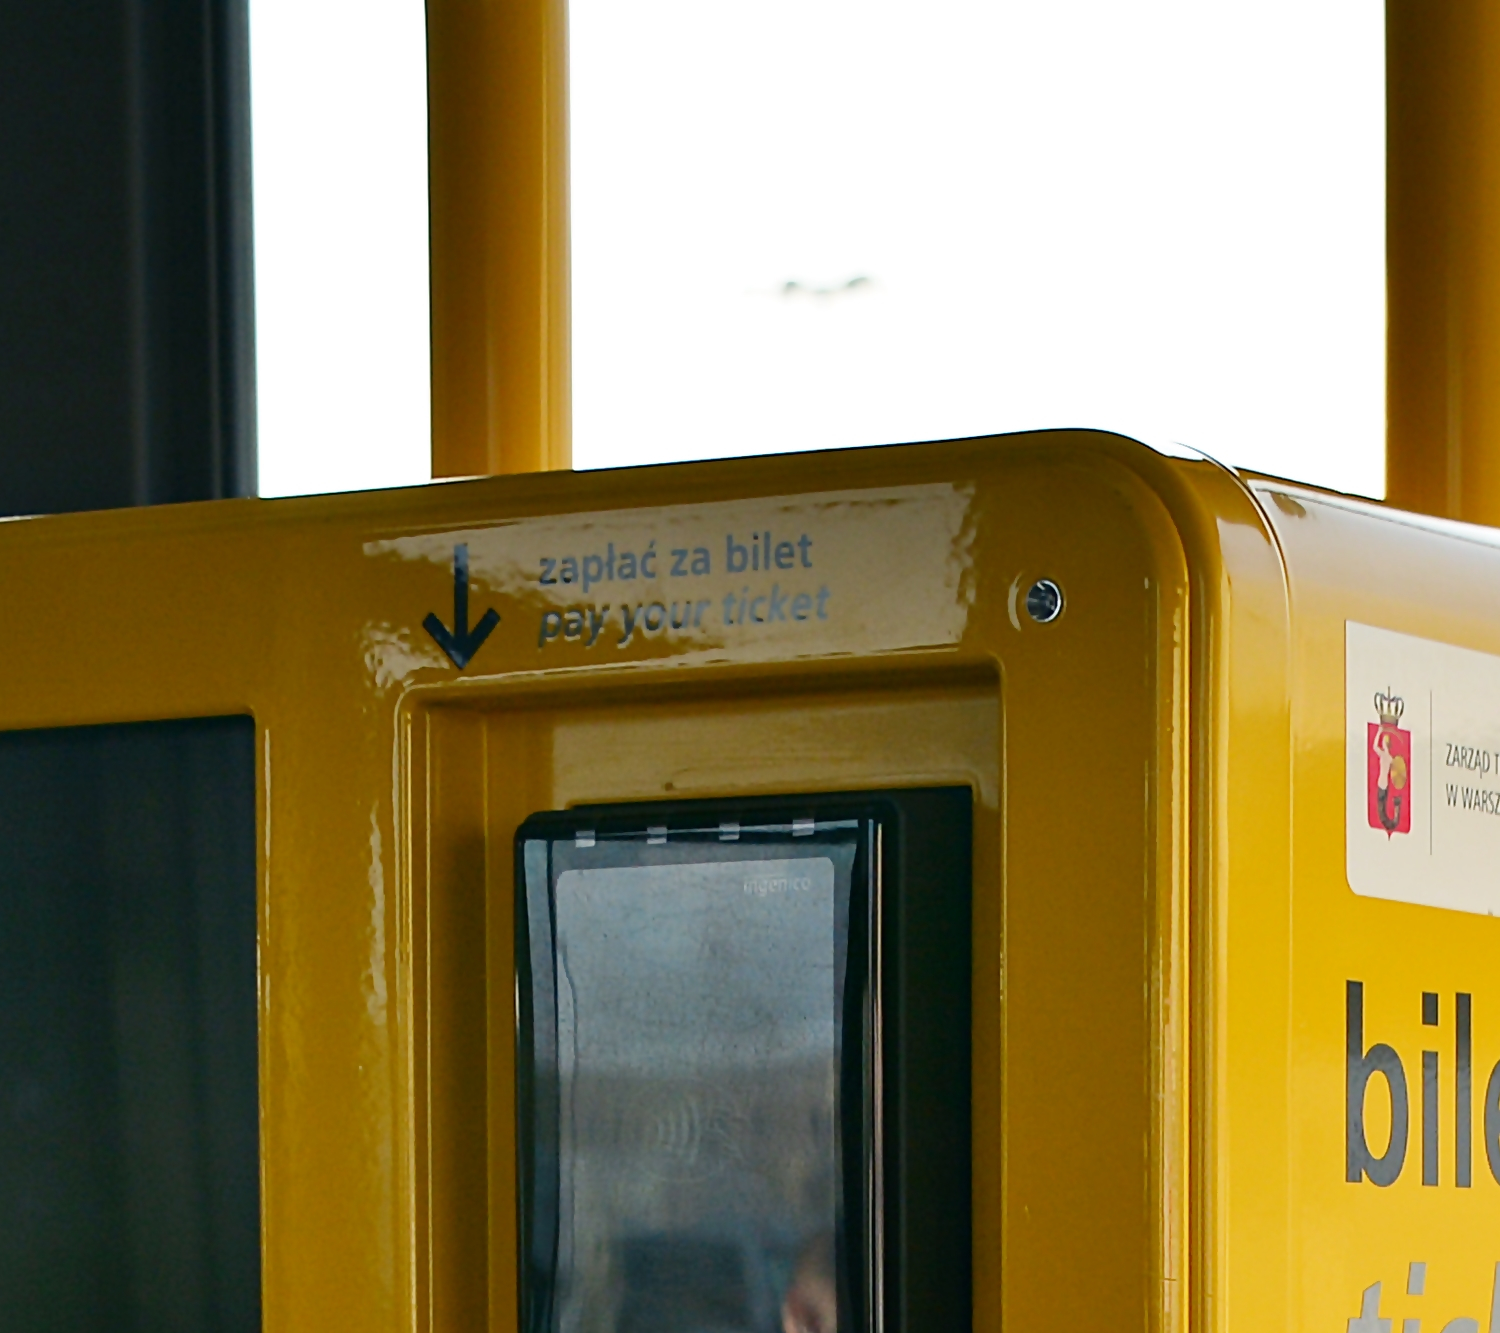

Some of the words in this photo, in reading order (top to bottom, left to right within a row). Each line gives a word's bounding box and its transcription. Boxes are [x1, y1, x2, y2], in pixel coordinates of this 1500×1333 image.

[539, 540, 656, 594] zapłać
[669, 547, 711, 577] za
[726, 531, 812, 574] bilet
[538, 602, 608, 647] pay
[619, 599, 710, 647] your
[722, 584, 832, 626] ticket
[1445, 743, 1491, 780] ZARZĄD
[1445, 783, 1457, 807] W
